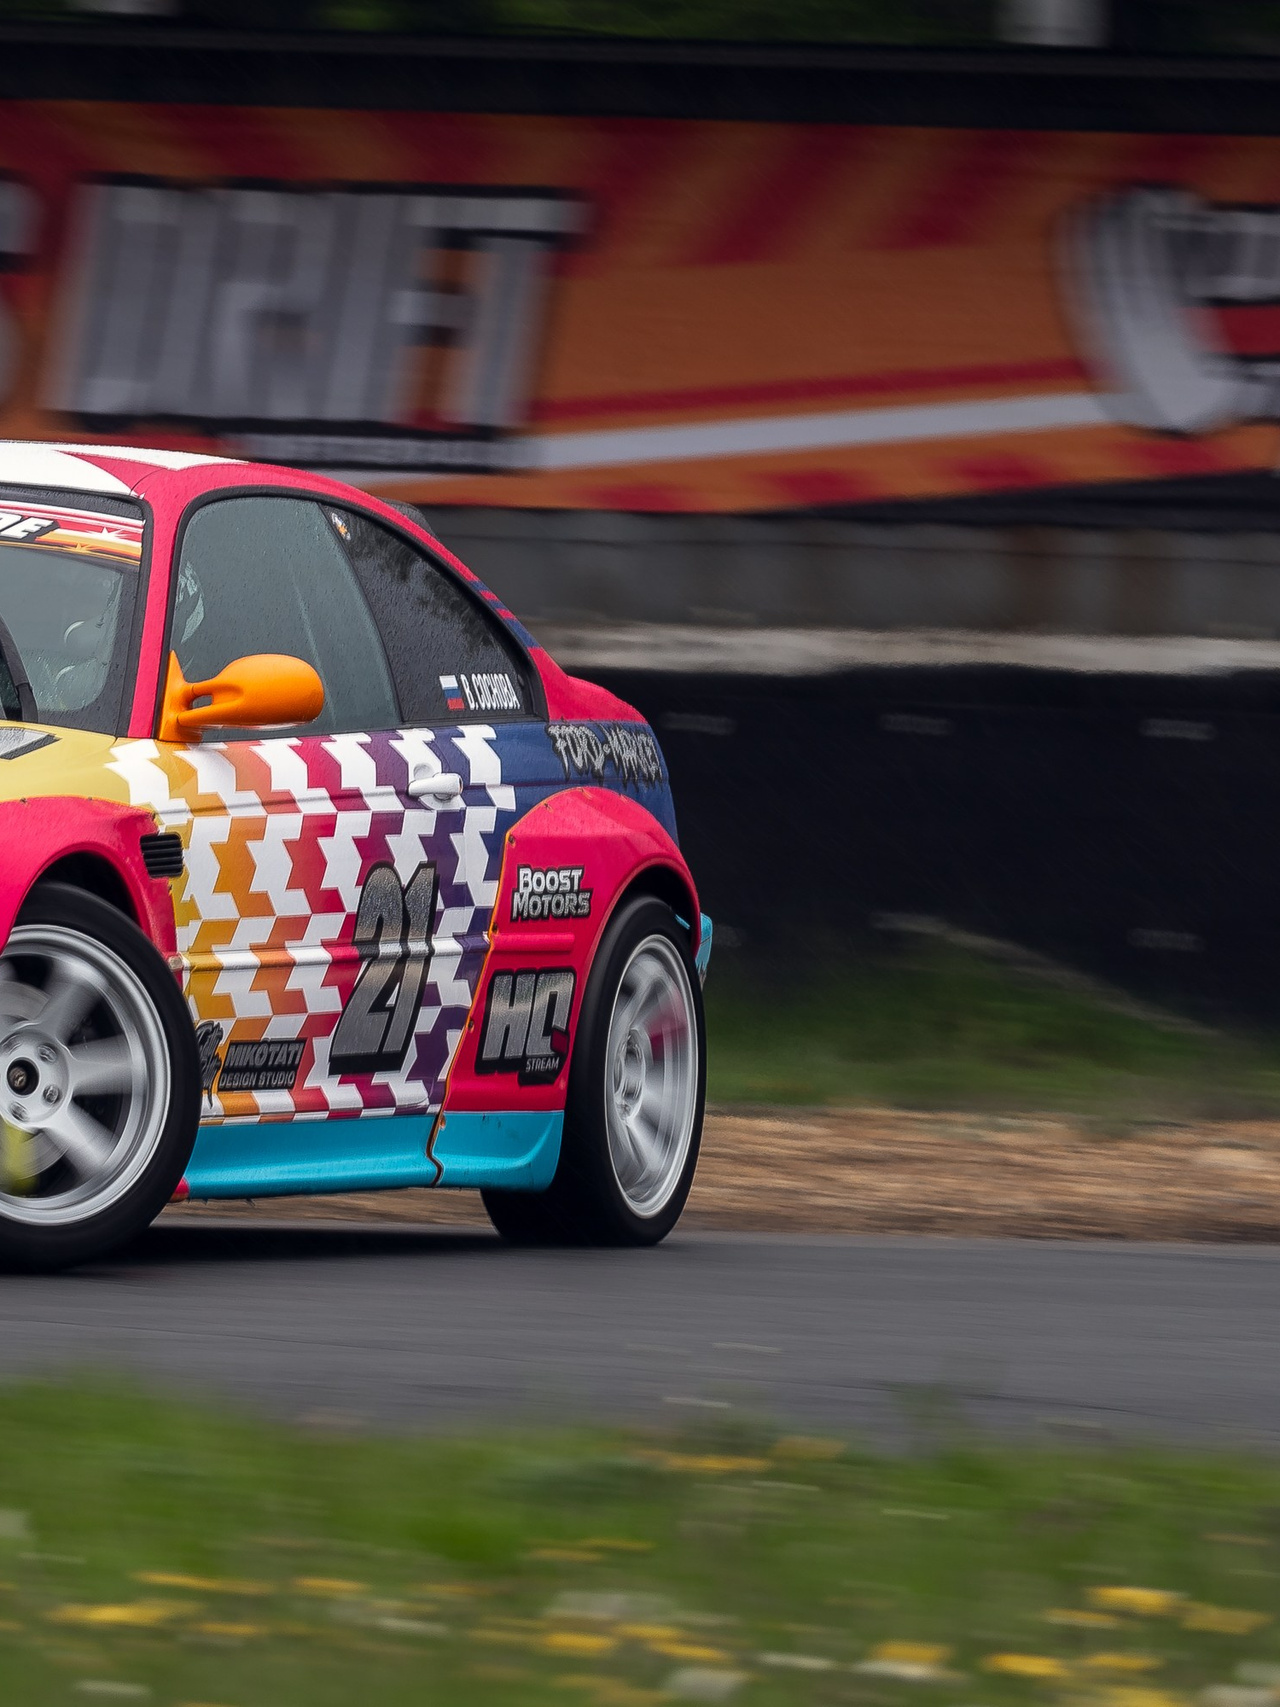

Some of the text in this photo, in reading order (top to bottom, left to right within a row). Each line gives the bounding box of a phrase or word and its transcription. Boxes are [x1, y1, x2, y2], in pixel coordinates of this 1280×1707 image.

[38, 181, 582, 426] DRIFT
[518, 866, 584, 893] BOOST
[511, 891, 591, 920] MOTORS
[329, 862, 438, 1065] 21
[525, 1057, 560, 1073] STREAM
[219, 1070, 296, 1089] DESIGN STUDIO
